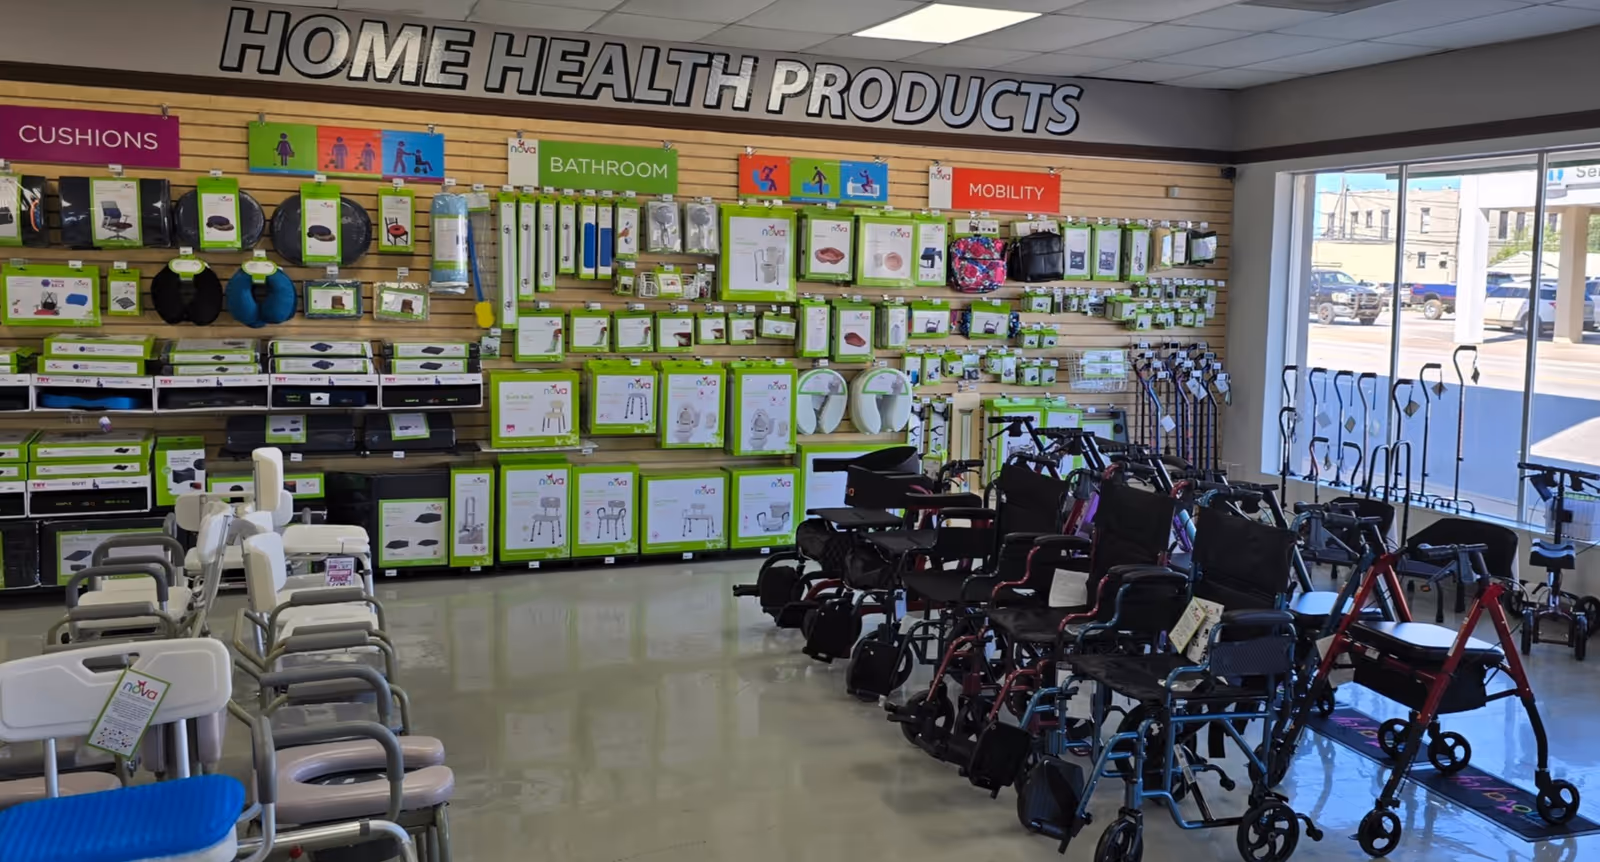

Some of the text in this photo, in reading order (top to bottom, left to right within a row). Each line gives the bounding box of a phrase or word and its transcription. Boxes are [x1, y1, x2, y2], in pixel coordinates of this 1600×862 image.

[219, 7, 1084, 135] HOME HEALTH PRODUCTS
[18, 124, 159, 150] CUSHIONS
[511, 142, 536, 154] nova
[550, 156, 668, 179] BATHROOM
[931, 170, 951, 181] nova
[969, 183, 1045, 201] MOBILITY
[762, 226, 786, 237] nova
[831, 225, 848, 233] nova
[890, 230, 910, 239] nova
[628, 380, 652, 390] nova
[696, 377, 717, 386] nova
[768, 382, 788, 390] nova
[544, 386, 568, 395] nova
[539, 475, 565, 485] nova
[608, 478, 628, 486] nova
[771, 479, 791, 488] nova
[695, 486, 716, 495] nova
[123, 680, 158, 701] nova
